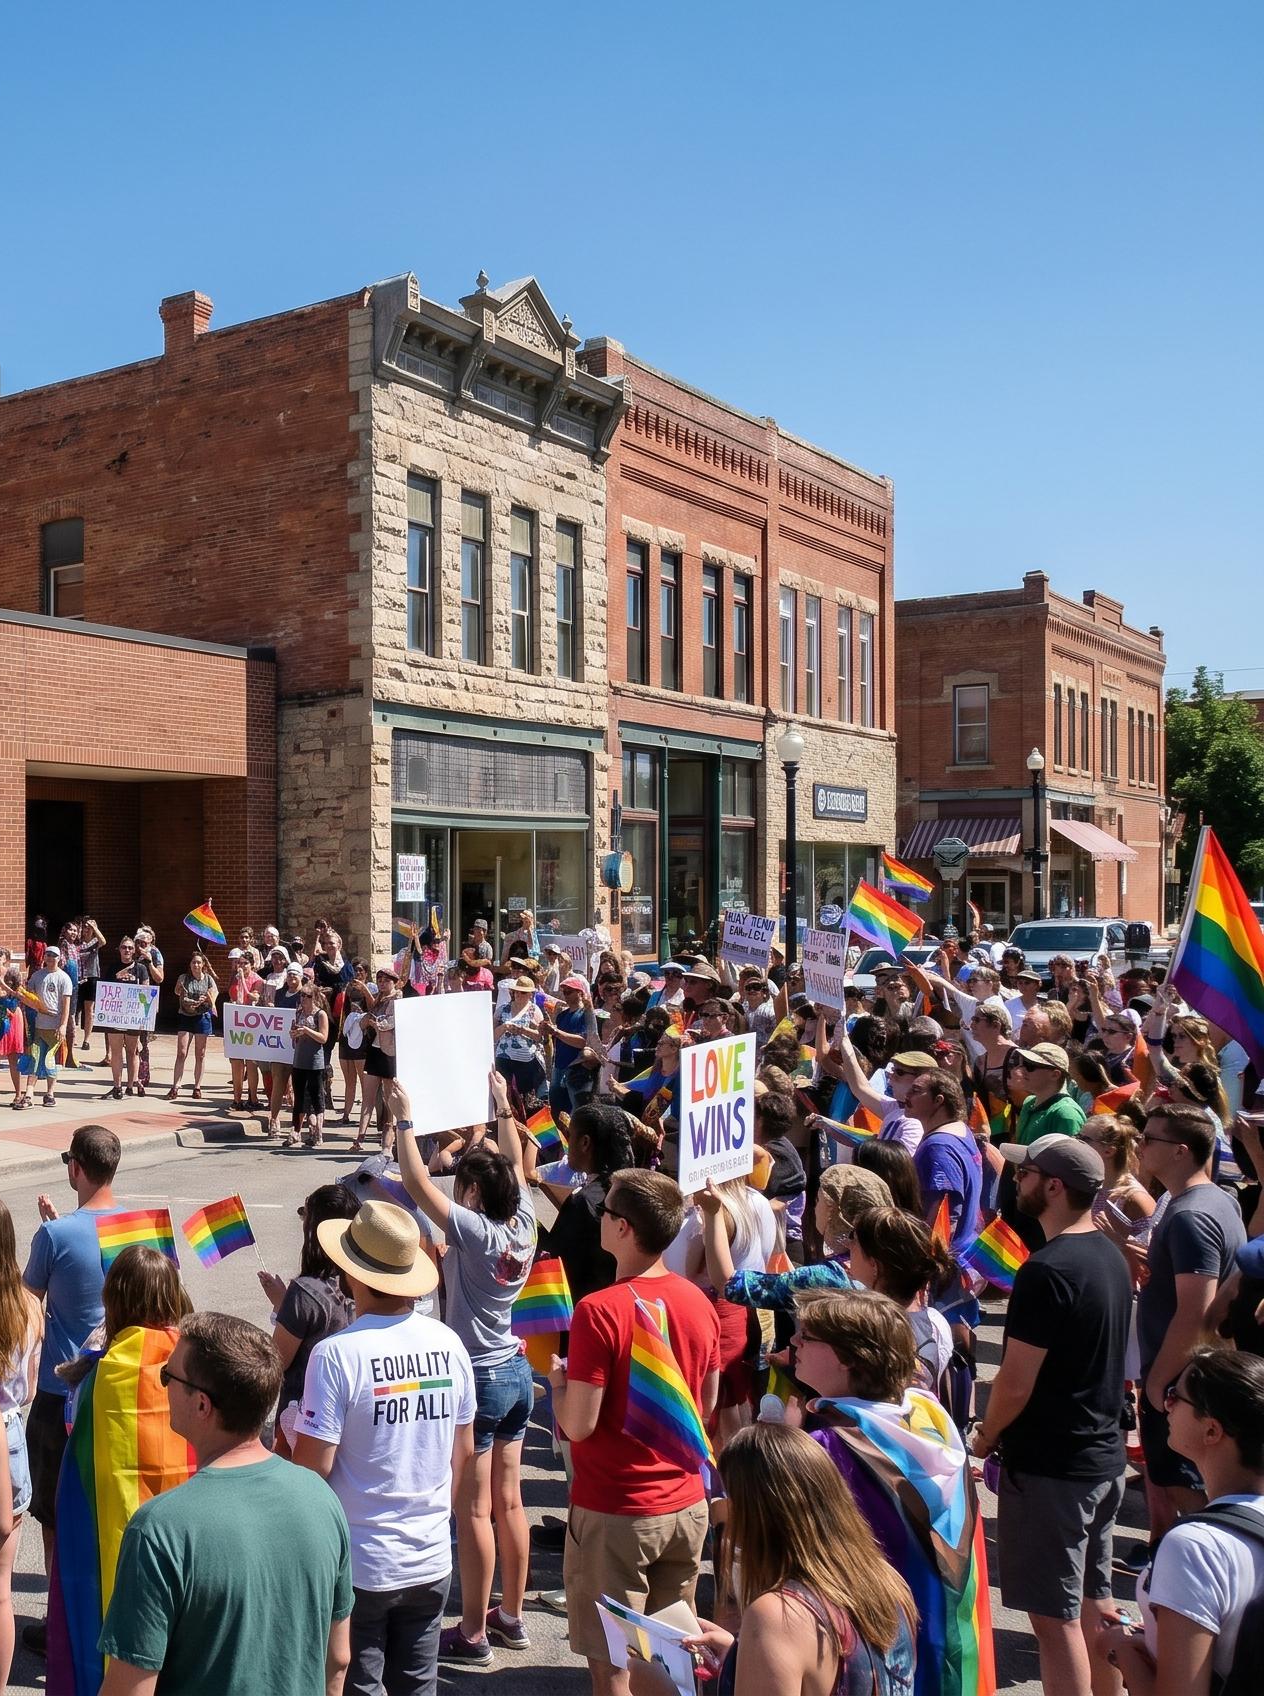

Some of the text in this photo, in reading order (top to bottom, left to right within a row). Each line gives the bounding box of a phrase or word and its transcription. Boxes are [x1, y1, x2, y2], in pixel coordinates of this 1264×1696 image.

[234, 1010, 284, 1031] LOVE
[691, 1041, 746, 1104] LOVE
[688, 1097, 746, 1160] WINS
[370, 1350, 450, 1382] EQUALITY
[373, 1393, 450, 1426] FOR ALL
